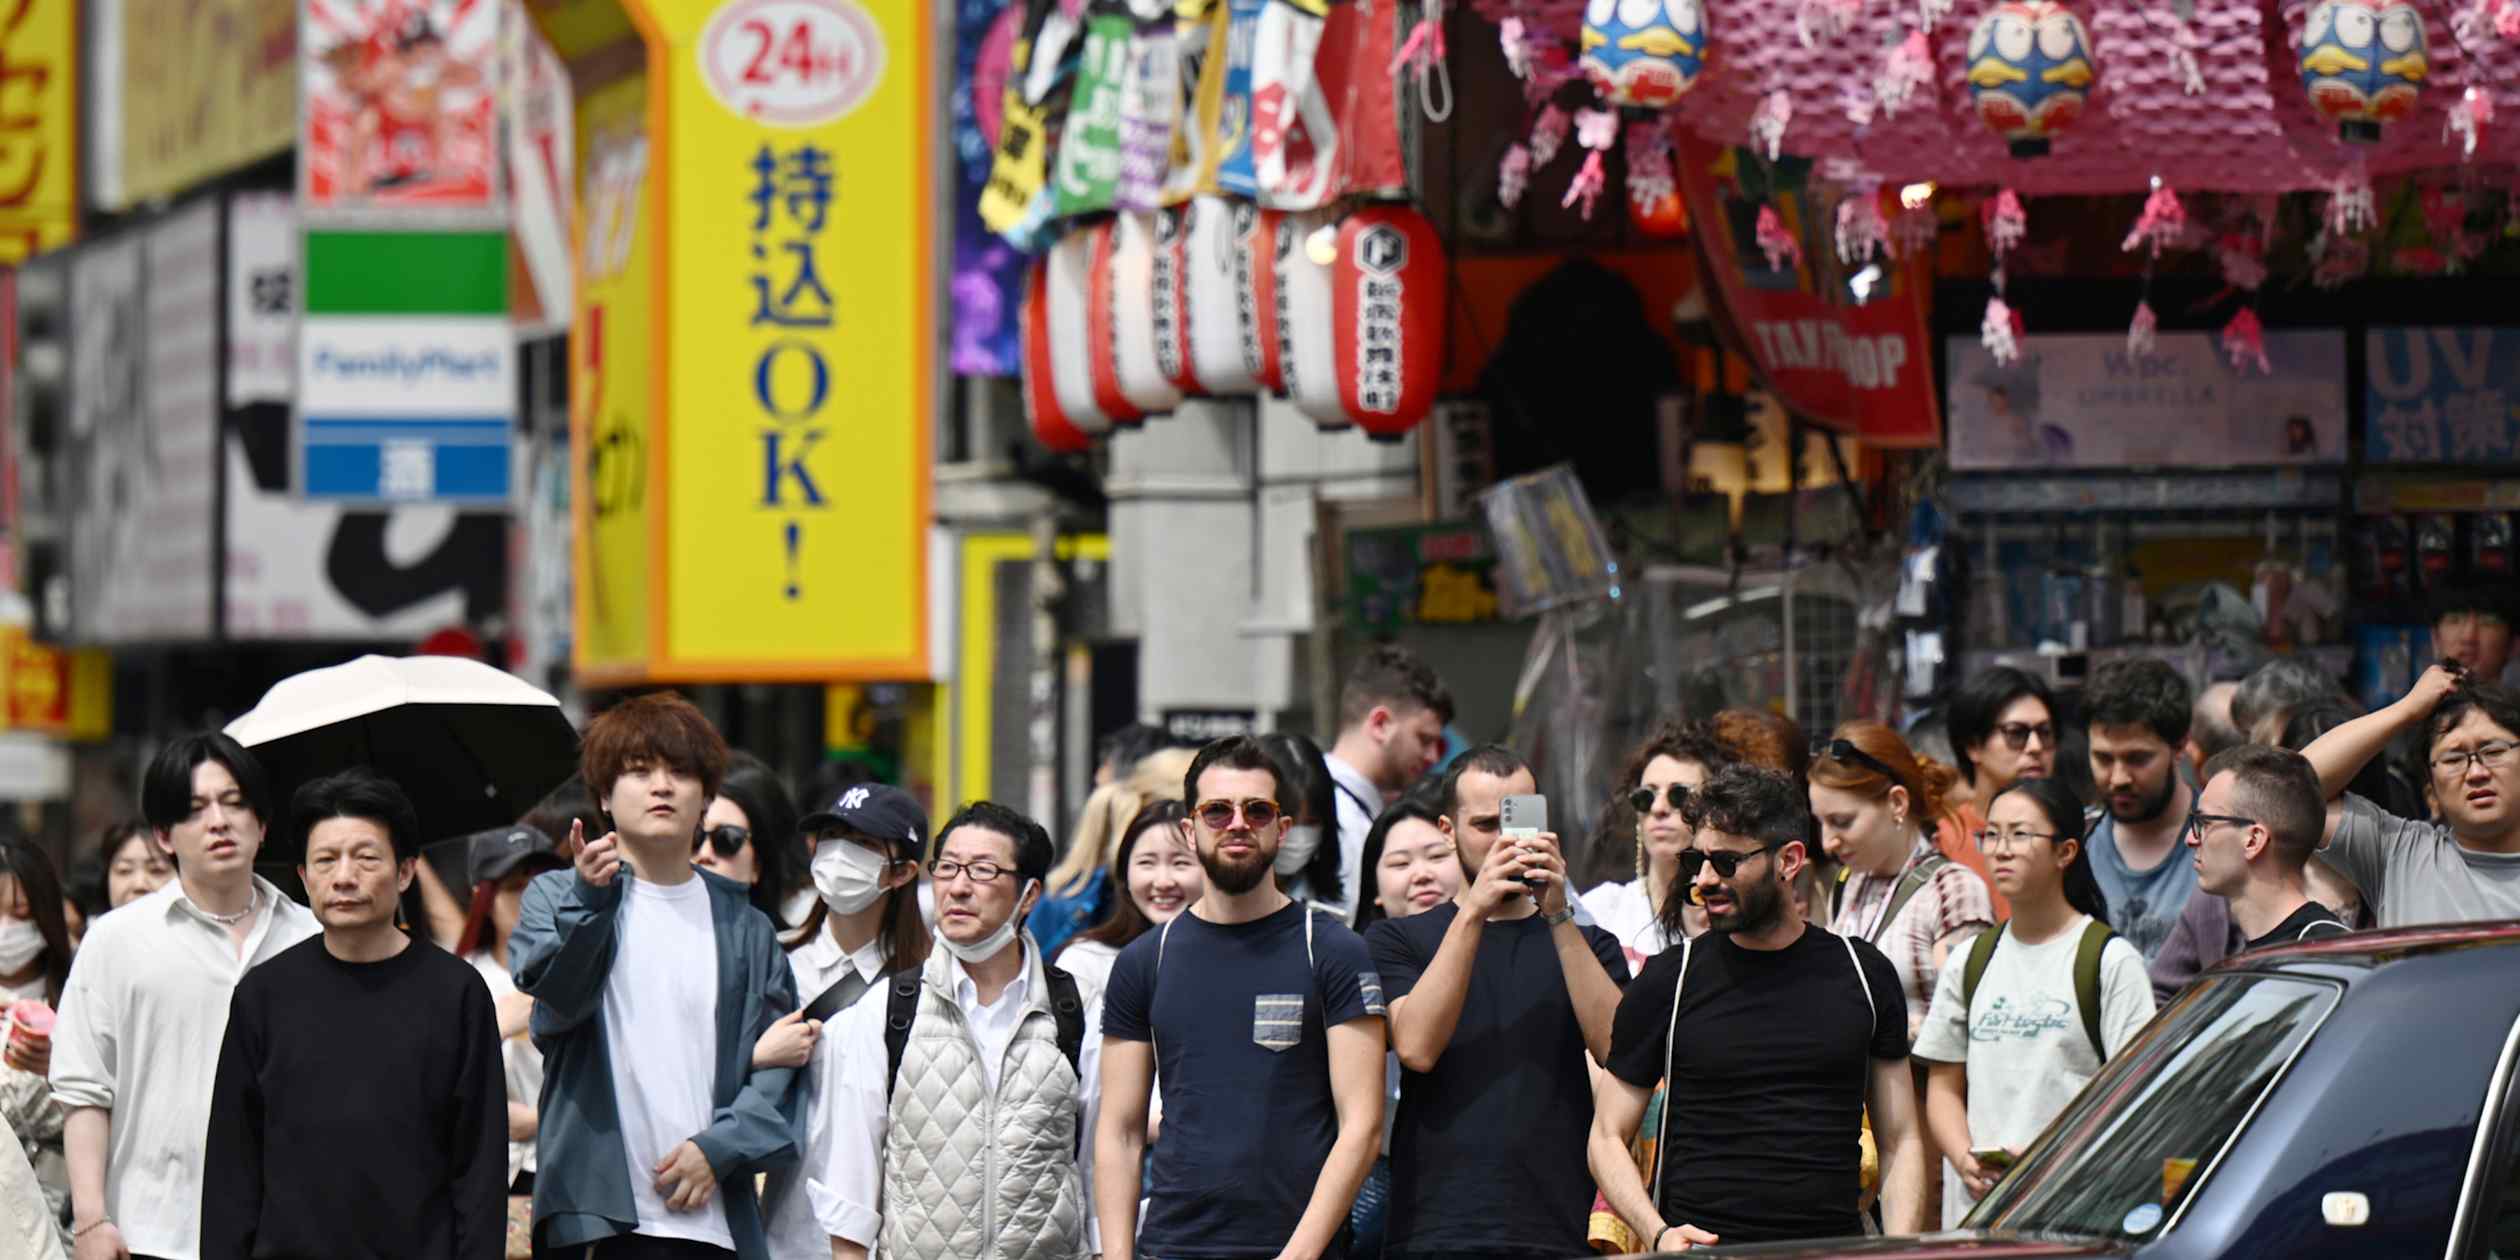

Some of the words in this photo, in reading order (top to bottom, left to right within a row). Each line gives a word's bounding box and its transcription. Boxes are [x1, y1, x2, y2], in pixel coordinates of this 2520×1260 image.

[742, 19, 850, 84] 24H
[747, 143, 837, 600] 持込OK!
[2366, 326, 2495, 398] UV
